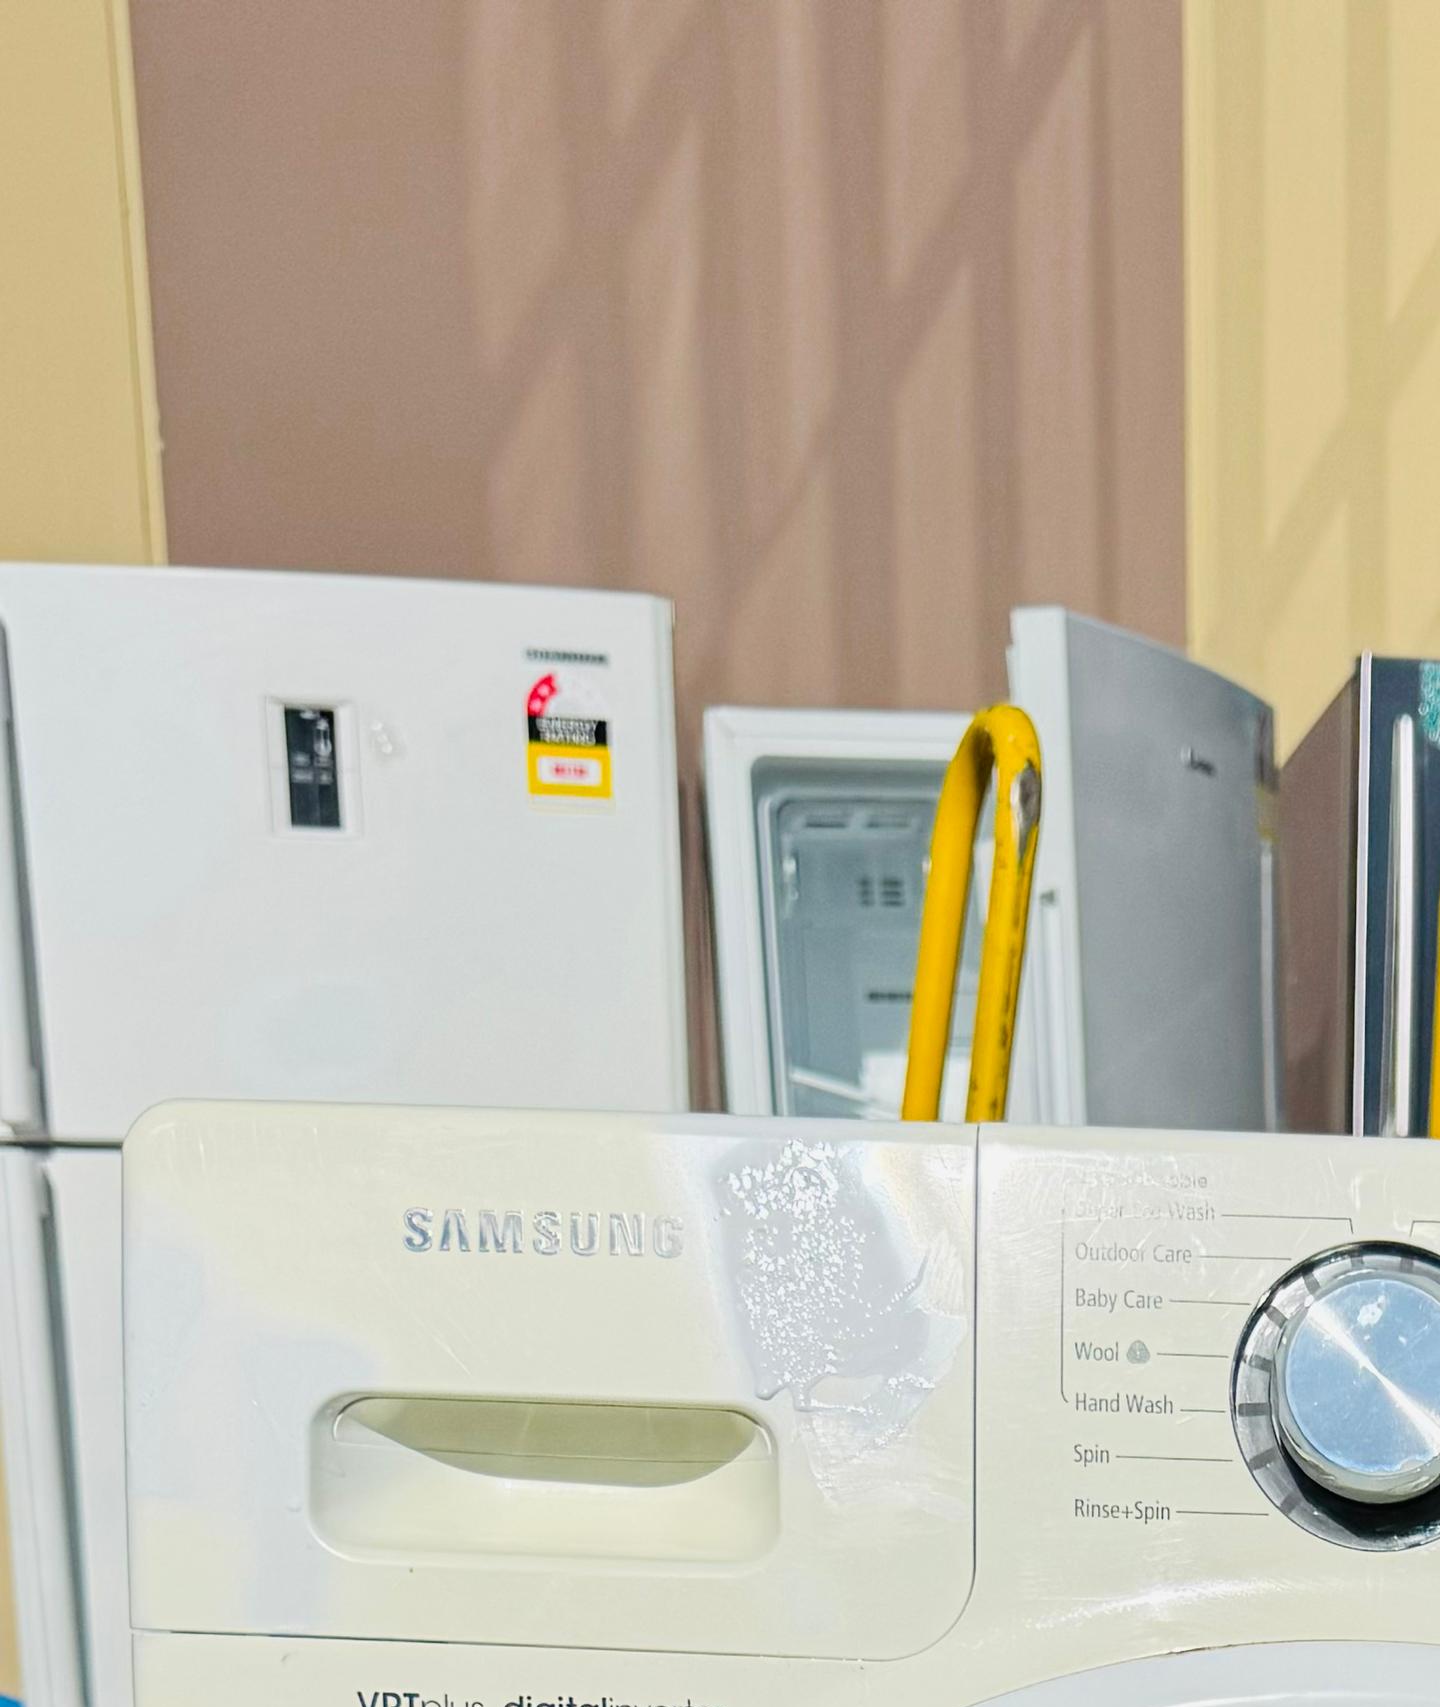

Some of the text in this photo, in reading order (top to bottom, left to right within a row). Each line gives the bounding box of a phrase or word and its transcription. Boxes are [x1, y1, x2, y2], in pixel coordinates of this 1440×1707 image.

[1167, 1200, 1215, 1221] Wash
[401, 1206, 685, 1259] SAMSUNG
[1075, 1242, 1193, 1264] Outdoor Care
[1075, 1288, 1163, 1313] Baby Care
[1074, 1342, 1119, 1361] Wool
[1075, 1392, 1173, 1414] Hand Wash
[1073, 1444, 1110, 1467] Spin
[1074, 1499, 1171, 1524] Rinse+Spin
